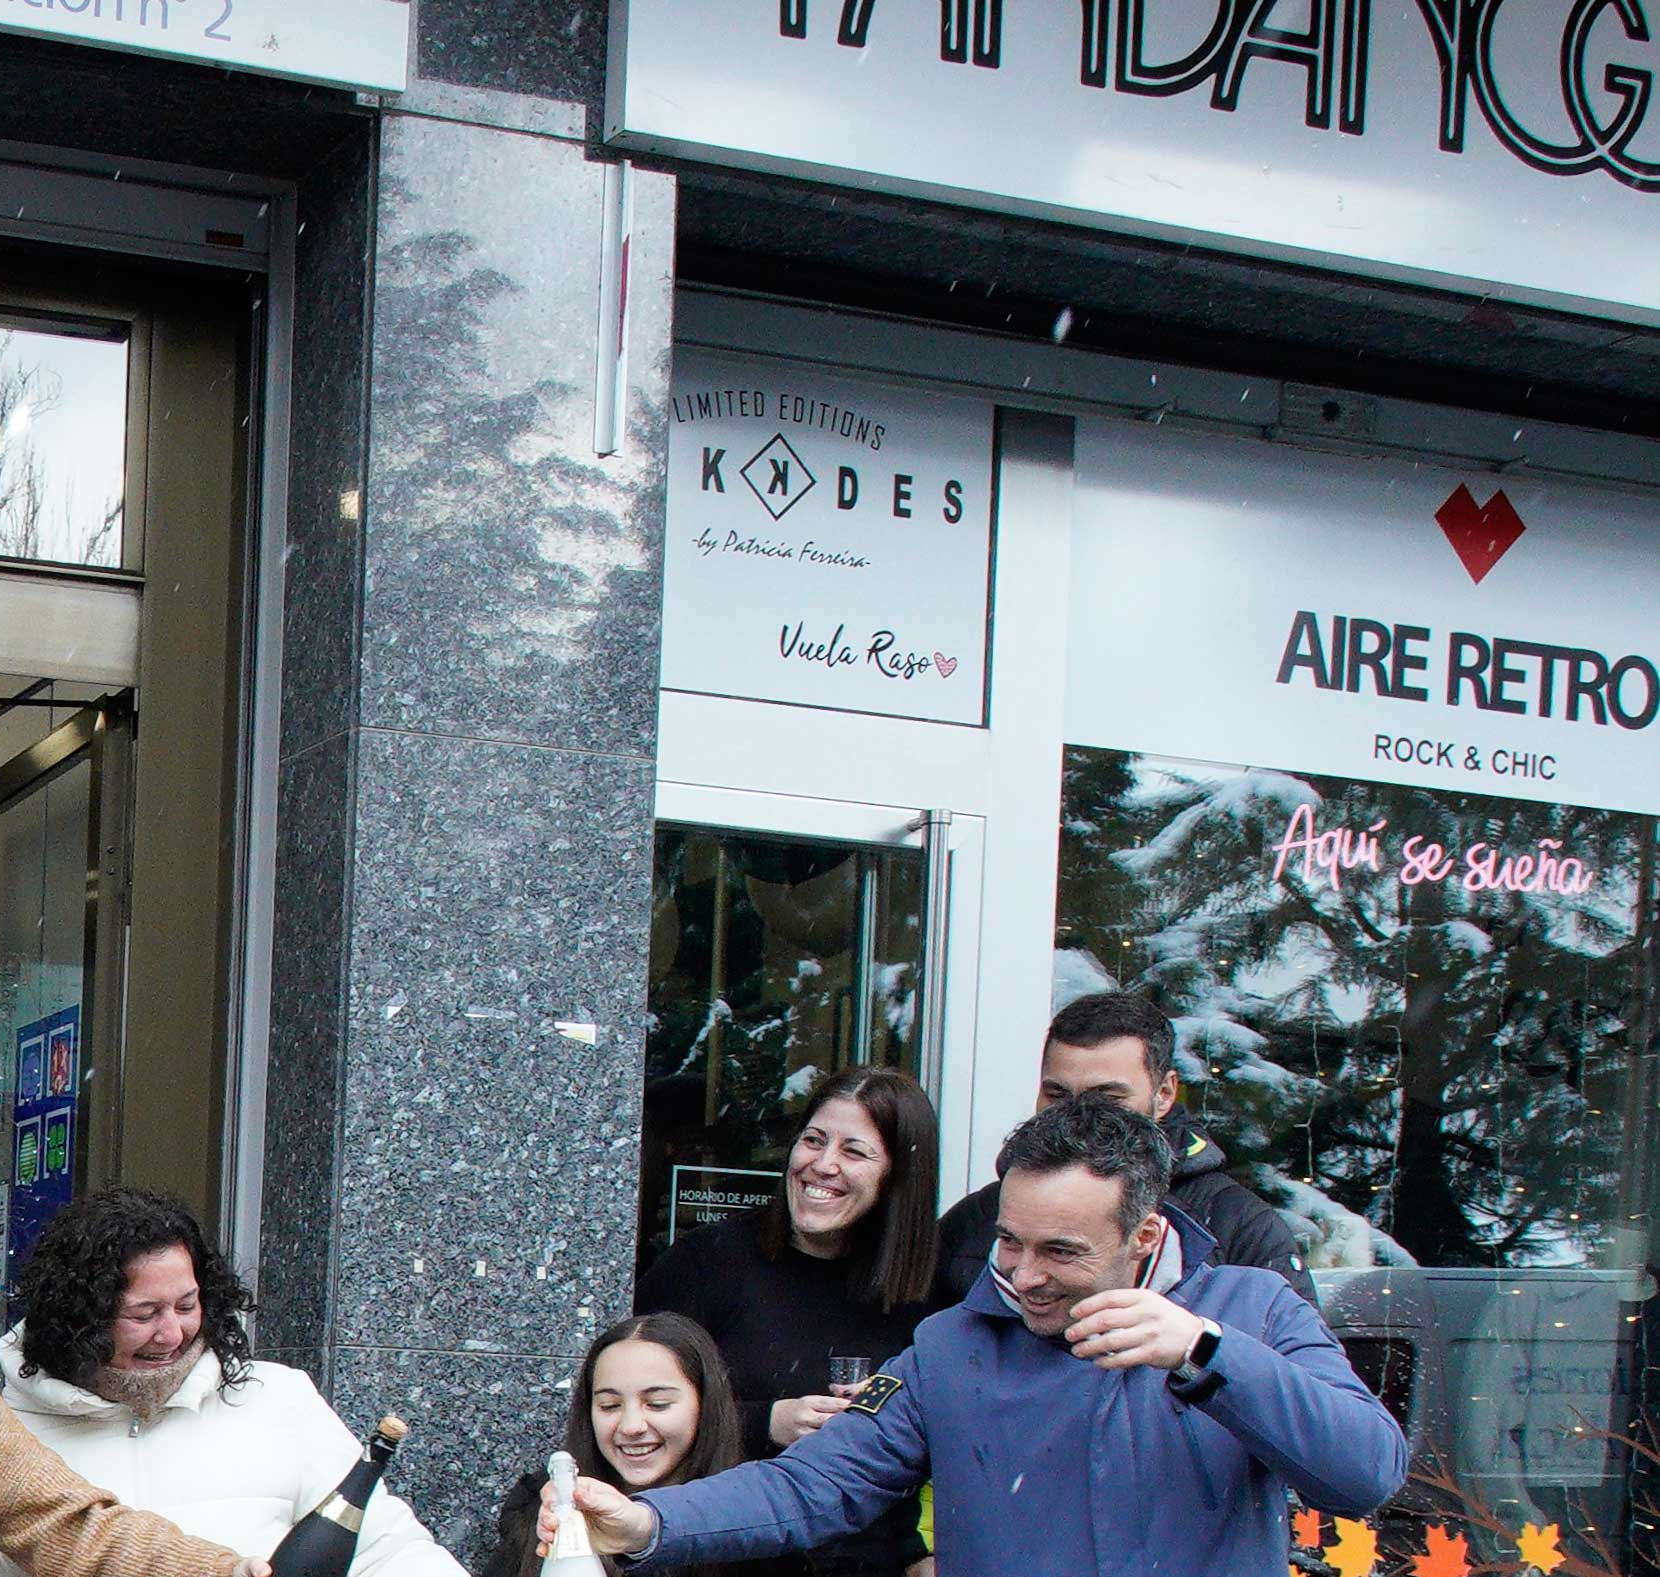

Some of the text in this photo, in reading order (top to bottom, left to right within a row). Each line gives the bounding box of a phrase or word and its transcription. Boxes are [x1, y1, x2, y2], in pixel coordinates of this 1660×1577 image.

[672, 390, 886, 451] LIMITED EDITIONS
[722, 529, 793, 560] Patricia
[779, 620, 933, 681] Vuela Raso
[1274, 609, 1660, 731] AIRE RETRO
[1373, 733, 1557, 780] ROCK & CHIC
[1271, 803, 1595, 896] Aquí se sueña
[679, 1189, 726, 1203] HORARIO
[726, 1192, 740, 1204] DE
